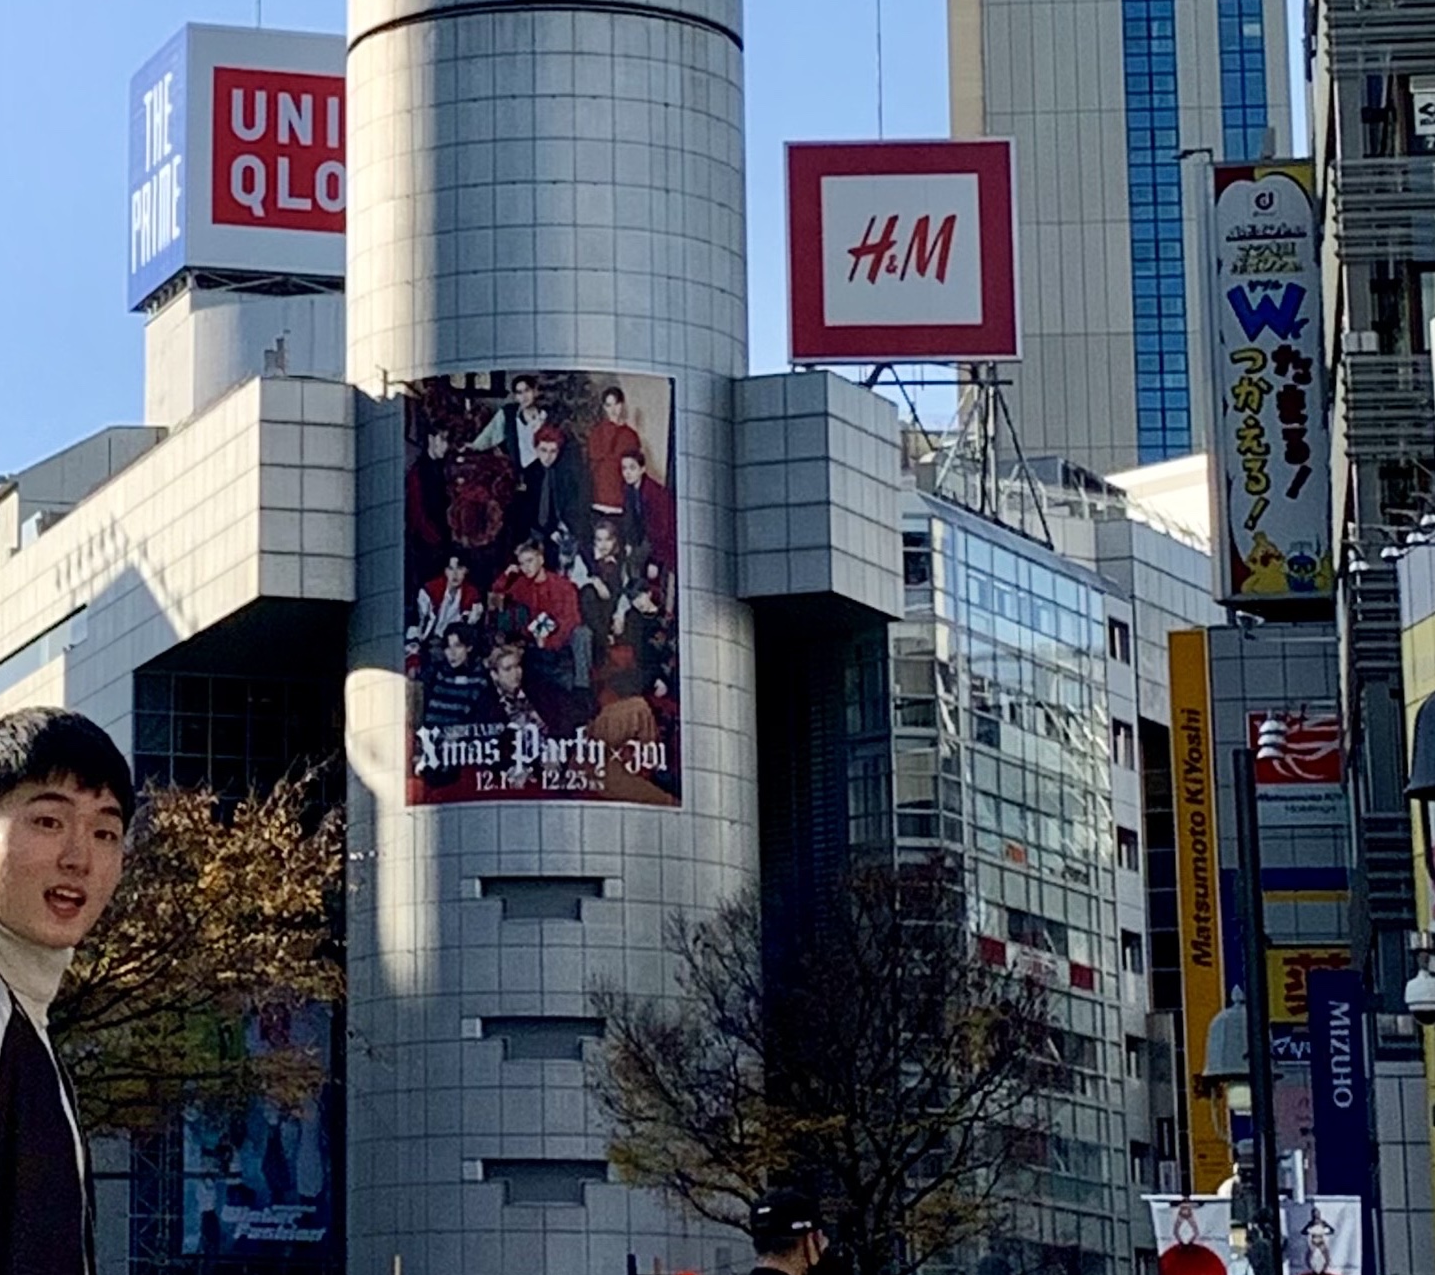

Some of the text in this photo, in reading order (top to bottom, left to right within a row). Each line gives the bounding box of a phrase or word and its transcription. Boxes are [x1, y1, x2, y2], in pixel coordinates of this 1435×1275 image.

[143, 71, 172, 172] THE
[231, 88, 339, 149] UNI
[132, 154, 182, 274] PRIME
[230, 154, 346, 217] QLO
[848, 214, 957, 284] H&M
[415, 725, 501, 775] Xmas
[507, 723, 606, 776] Party
[1328, 1000, 1354, 1109] MIZUHO
